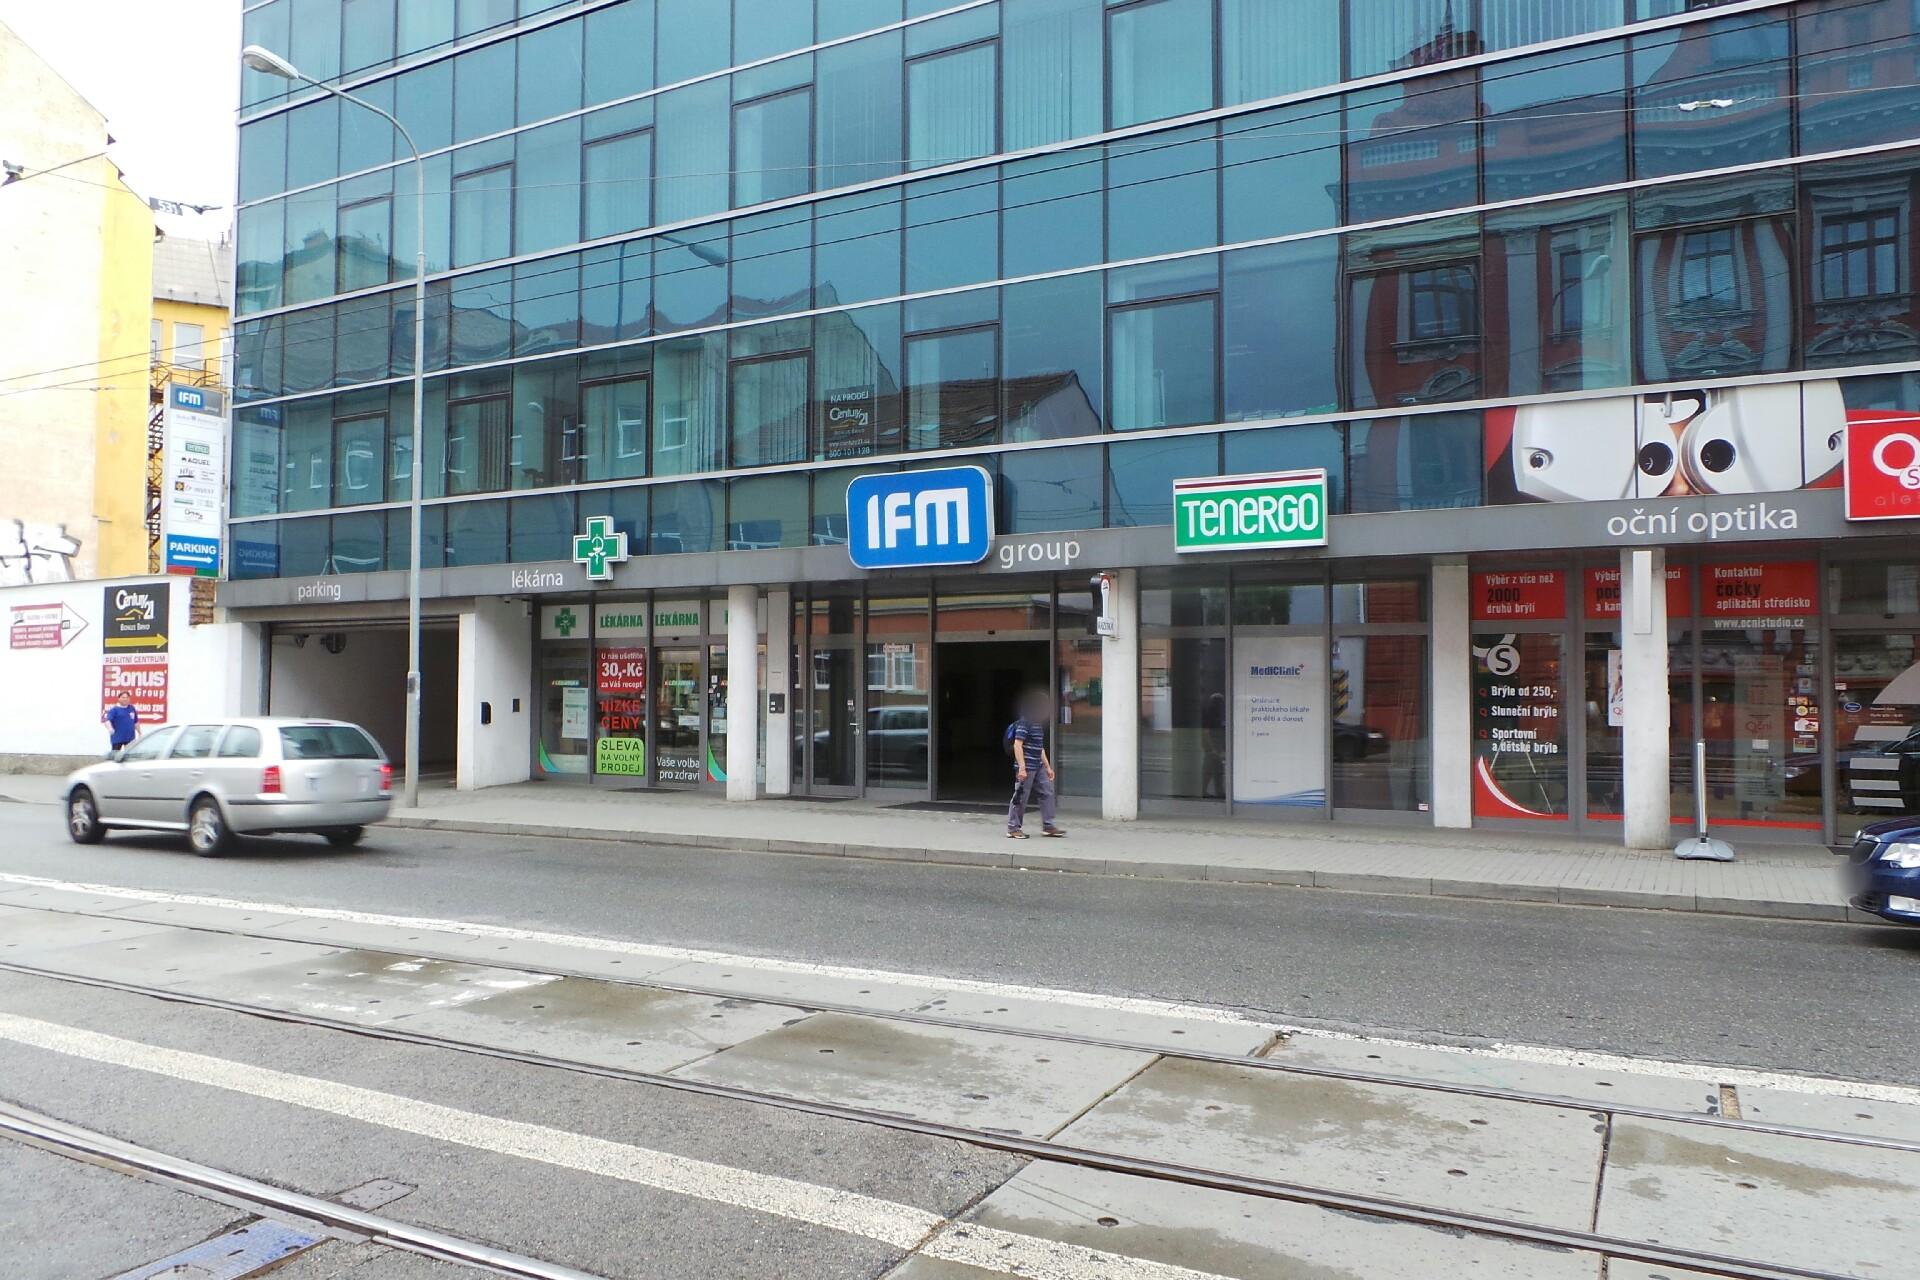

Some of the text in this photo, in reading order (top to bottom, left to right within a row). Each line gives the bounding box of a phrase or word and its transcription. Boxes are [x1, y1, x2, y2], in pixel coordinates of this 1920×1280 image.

[178, 391, 201, 406] IFM
[830, 390, 869, 403] NA PRODEJ
[829, 407, 869, 425] Century 21
[867, 487, 970, 550] IFM
[1607, 502, 1798, 539] oční optika
[169, 541, 217, 555] PARKING
[999, 540, 1081, 569] group
[1714, 565, 1763, 578] Kontaktní
[511, 569, 563, 589] lékárna
[1486, 574, 1510, 586] Výběr
[1519, 573, 1536, 584] více
[1539, 573, 1554, 583] než
[298, 581, 341, 602] parking
[1487, 587, 1521, 602] 2000
[1716, 580, 1761, 598] čočky
[115, 589, 154, 620] Century 21
[1486, 602, 1536, 615] druhů brýlí
[1716, 596, 1811, 611] aplikační středisko
[599, 612, 643, 629] LÉKÁRNA
[655, 611, 699, 627] LÉKÁRNA
[1714, 617, 1804, 629] www.ocnistudio.cz
[133, 655, 166, 663] CENTRUM
[1495, 647, 1512, 673] S
[105, 665, 165, 687] Bonus
[601, 662, 643, 680] 30,-Kč
[1250, 666, 1301, 676] MediClinic
[609, 680, 621, 688] Váš
[622, 681, 642, 689] recept
[1491, 684, 1558, 699] Brýle od 250,-
[135, 687, 165, 700] Group
[1491, 704, 1558, 719] Sluneční brýle
[600, 716, 641, 730] CENY
[1492, 728, 1537, 740] Sportovní
[601, 740, 641, 751] SLEVA
[1491, 741, 1558, 755] a dětské brýle
[600, 752, 641, 762] NA VOLNÝ
[656, 756, 700, 769] Vaše volba
[601, 762, 640, 773] PRODEJ
[659, 770, 674, 781] pro
